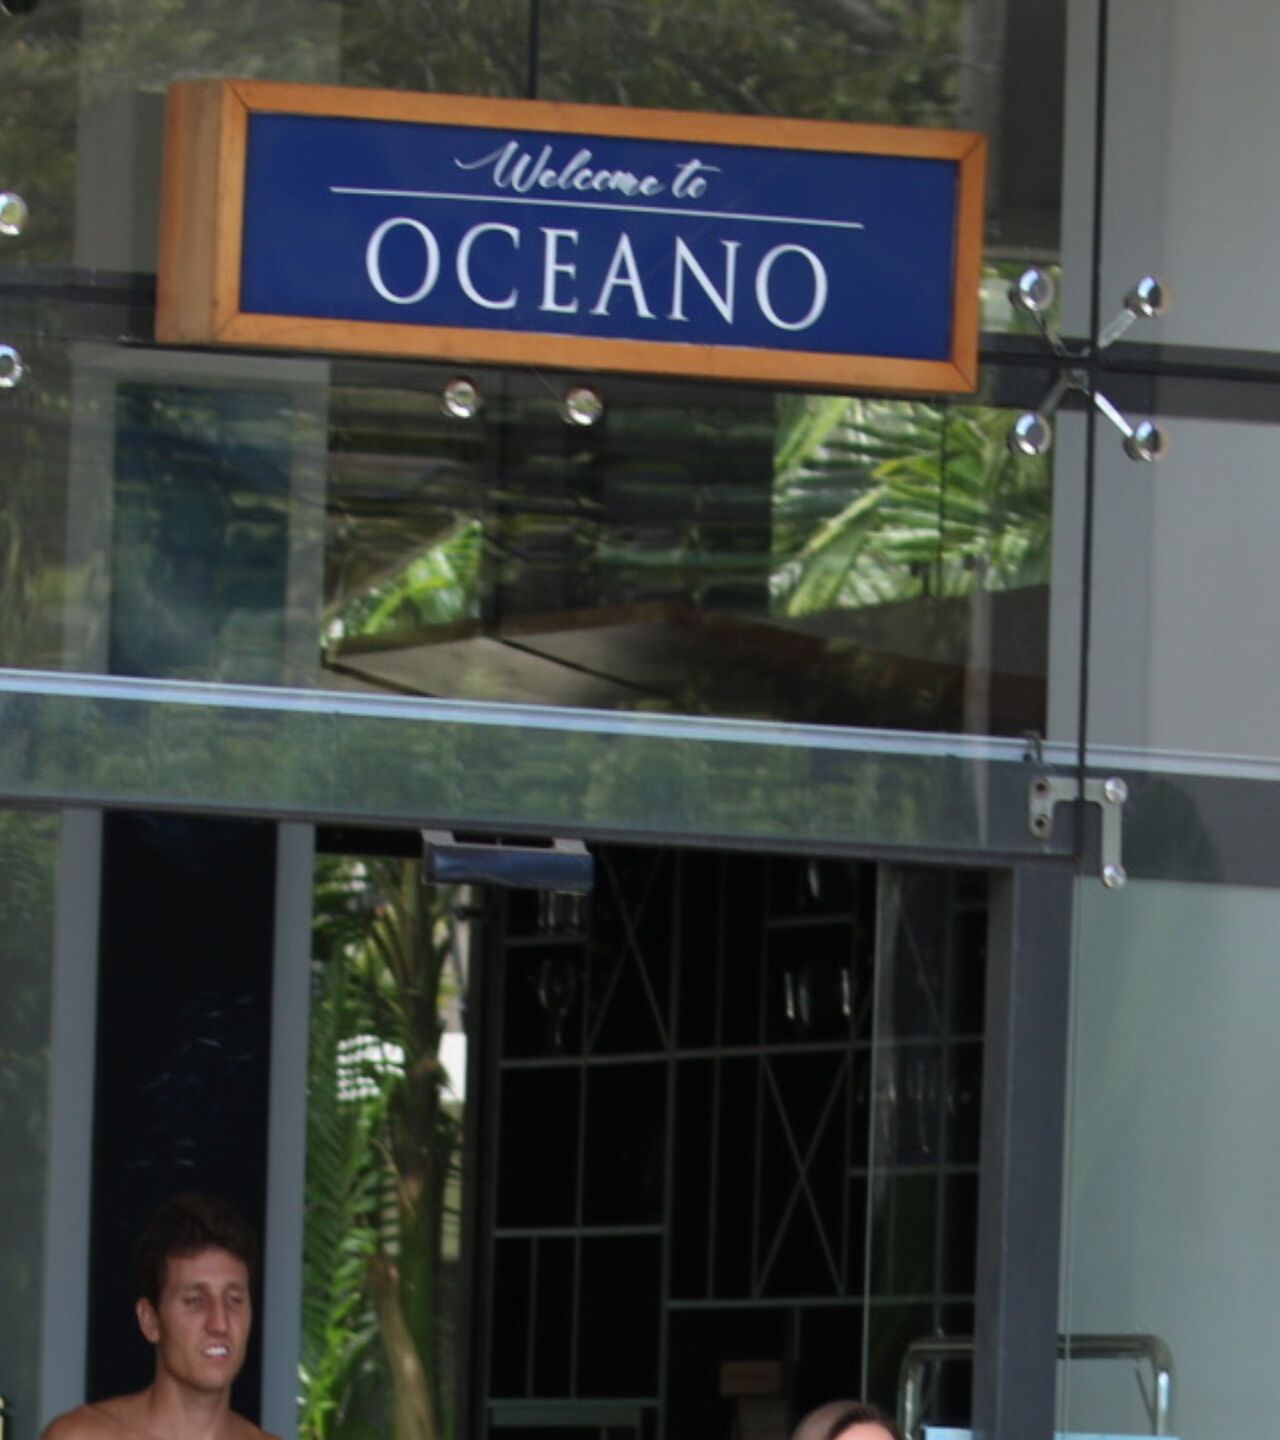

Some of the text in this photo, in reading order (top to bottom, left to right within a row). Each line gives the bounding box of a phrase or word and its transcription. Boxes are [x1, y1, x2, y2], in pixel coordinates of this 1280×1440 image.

[454, 139, 722, 199] Welcome to
[365, 216, 829, 332] OCEANO
